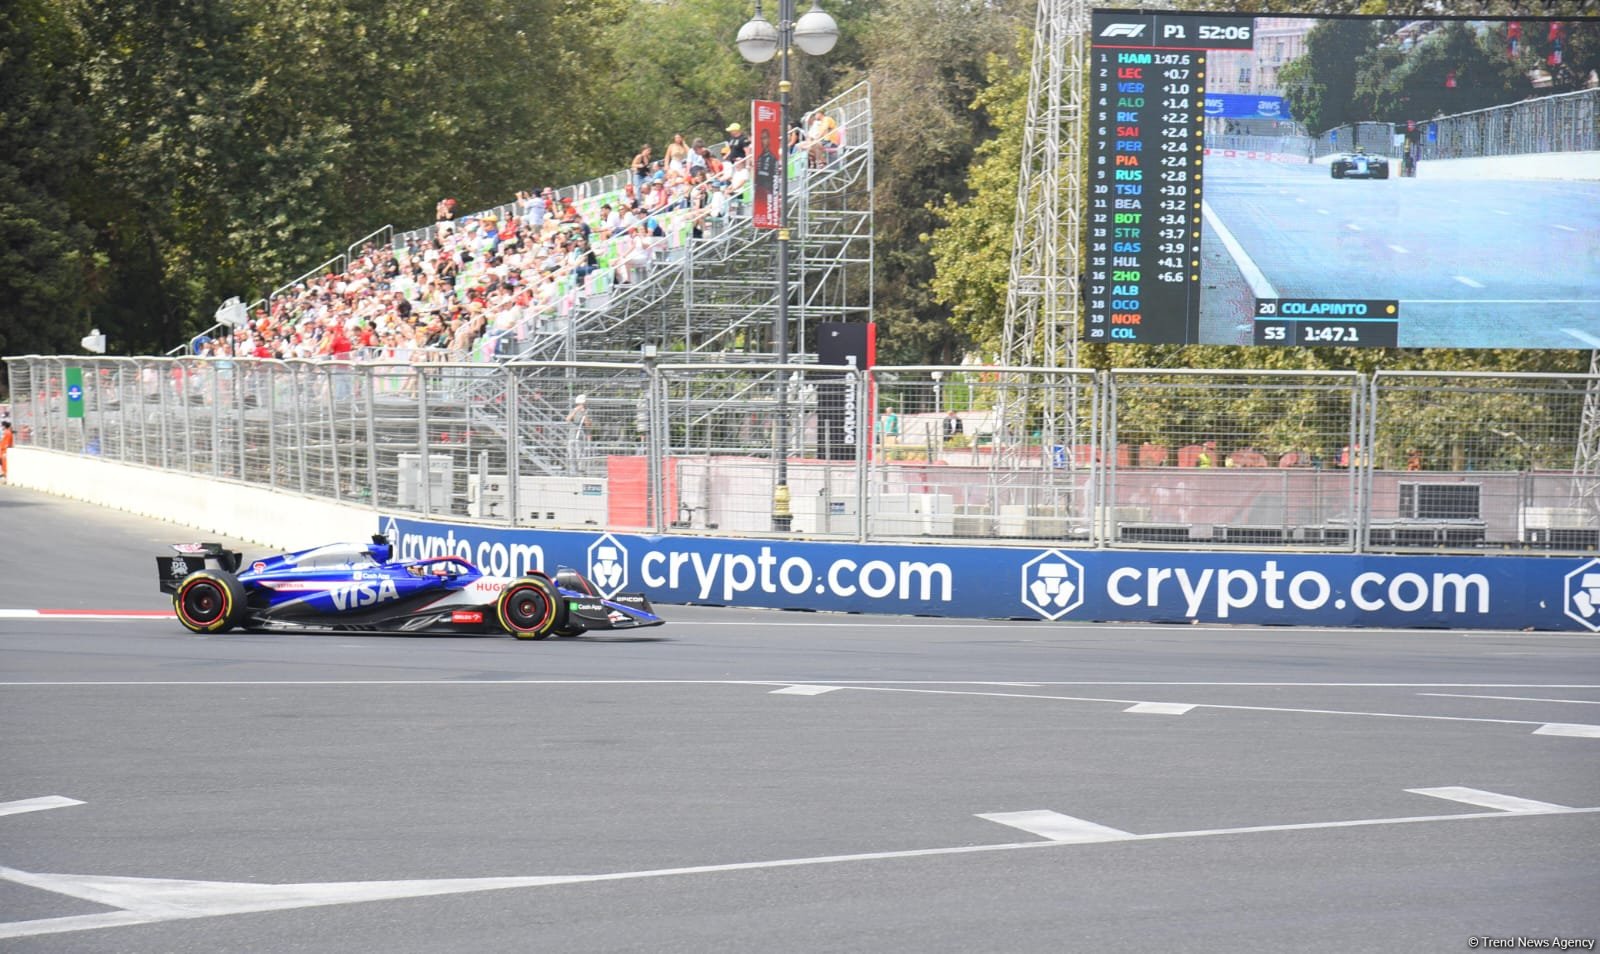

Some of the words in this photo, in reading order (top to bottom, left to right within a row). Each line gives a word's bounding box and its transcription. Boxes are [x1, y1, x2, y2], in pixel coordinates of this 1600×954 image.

[1164, 24, 1186, 39] P1
[1199, 26, 1250, 40] 52:06
[1101, 54, 1108, 62] 1
[1118, 53, 1151, 64] HAM
[1154, 54, 1190, 65] 1:47.6
[1100, 68, 1108, 77] 2
[1117, 68, 1142, 79] LEC
[1163, 69, 1190, 79] +0.7
[1100, 83, 1107, 92] 3
[1117, 82, 1144, 93] VER
[1162, 83, 1190, 94] +1.0
[1099, 97, 1107, 106] 4
[1118, 98, 1144, 107] ALO
[1162, 98, 1189, 109] +1.4
[1099, 112, 1107, 121] 5
[1117, 111, 1138, 122] RIC
[1161, 113, 1189, 123] +2.2
[1098, 127, 1106, 135] 6
[1117, 127, 1139, 137] SAI
[1161, 128, 1188, 138] +2.4
[1098, 141, 1106, 150] 7
[1116, 141, 1142, 151] PER
[1161, 142, 1188, 152] +2.4
[1098, 156, 1106, 164] 8
[1116, 155, 1138, 166] PIA
[1160, 157, 1187, 167] +2.4
[1097, 170, 1105, 179] 9
[1115, 169, 1143, 181] RUS
[1160, 171, 1187, 182] +2.8
[1094, 185, 1108, 193] 10
[1115, 184, 1141, 194] TSU
[1160, 185, 1186, 196] +3.0
[1094, 199, 1107, 207] 11
[1115, 199, 1142, 209] BEA
[1160, 200, 1186, 210] +3.2
[1094, 214, 1107, 222] 12
[1114, 213, 1142, 224] BOT
[1159, 214, 1186, 224] +3.4
[1094, 228, 1106, 237] 13
[1115, 228, 1140, 238] STR
[1159, 229, 1185, 239] +3.7
[1093, 243, 1106, 251] 14
[1113, 242, 1141, 253] GAS
[1158, 243, 1184, 253] +3.9
[1093, 257, 1106, 265] 15
[1113, 256, 1140, 267] HUL
[1158, 257, 1184, 268] +4.1
[1092, 272, 1105, 280] 16
[1113, 271, 1140, 281] ZHO
[1158, 272, 1184, 282] +6.6
[1092, 286, 1105, 294] 17
[1112, 285, 1139, 296] ALB
[1092, 300, 1105, 309] 18
[1112, 299, 1140, 310] OCO
[1259, 303, 1276, 314] 20
[1281, 302, 1367, 315] COLAPINTO
[1092, 314, 1104, 323] 19
[1112, 314, 1141, 324] NOR
[1091, 329, 1104, 337] 20
[1111, 328, 1136, 339] COL
[1264, 327, 1286, 340] S3
[1304, 326, 1359, 341] 1:47.1
[641, 547, 953, 601] crypto.com
[1106, 560, 1489, 617] crypto.com
[330, 580, 400, 610] VISA
